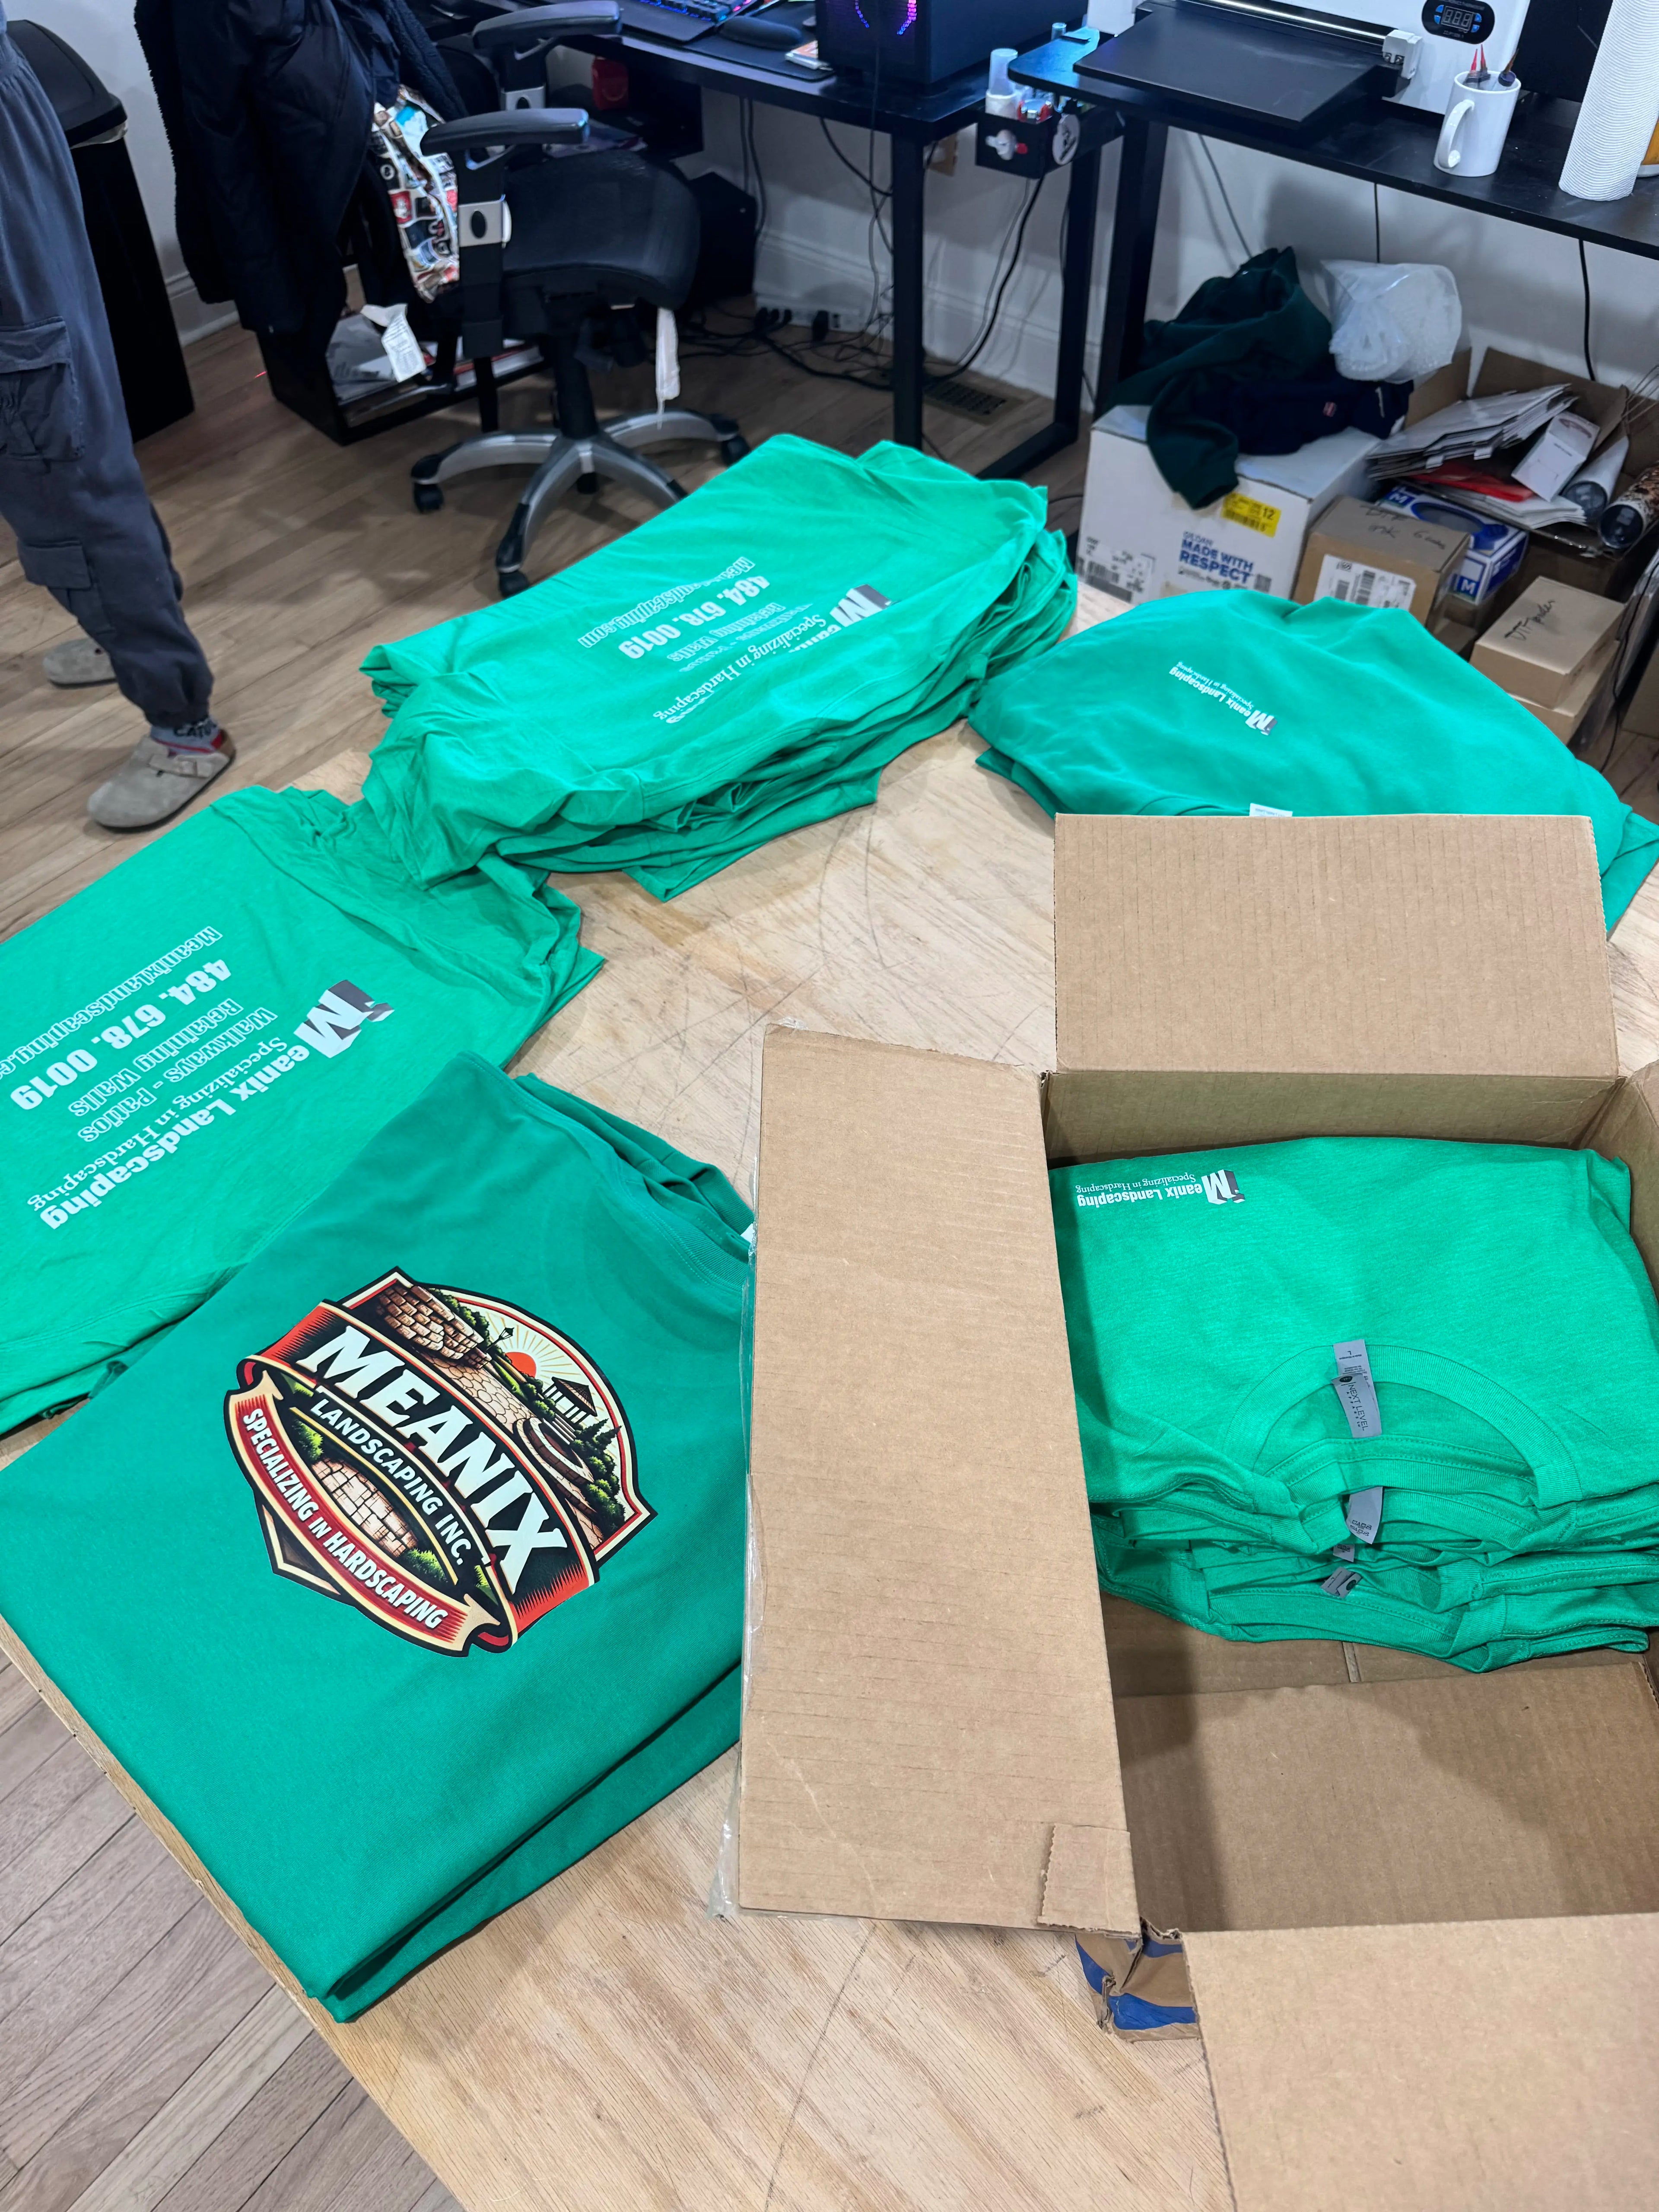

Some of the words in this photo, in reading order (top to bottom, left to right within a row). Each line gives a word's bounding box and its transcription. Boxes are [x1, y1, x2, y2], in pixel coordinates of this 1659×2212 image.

[1179, 550, 1252, 584] RESPECT
[1182, 539, 1217, 559] MADE
[1221, 552, 1253, 571] WITH
[717, 575, 770, 606] 484.
[1461, 579, 1475, 595] M
[674, 601, 726, 626] 678.
[710, 602, 786, 639] Retaining
[618, 623, 681, 659] 0019
[667, 635, 718, 661] Walls
[747, 614, 826, 661] Specializing
[737, 653, 756, 669] in
[1176, 661, 1214, 686] Hardscaping
[653, 666, 741, 721] Hardscaping
[1169, 666, 1227, 702] Landscaping
[1220, 683, 1254, 710] Specializing
[1226, 697, 1277, 735] Meanix
[159, 959, 232, 1005] 484.
[0, 925, 223, 1081] MeanixLandscaping.c
[91, 1004, 166, 1049] 678.
[133, 998, 244, 1072] Retaining
[163, 1007, 279, 1083] Walkways
[230, 979, 395, 1101] Meanix
[10, 1049, 98, 1110] 0019
[68, 1067, 140, 1117] Walls
[172, 1036, 288, 1110] Specializing
[78, 1087, 157, 1142] Patios
[156, 1109, 177, 1126] in
[27, 1125, 161, 1212] Hardscaping
[40, 1099, 236, 1230] Landscaping
[1142, 1172, 1196, 1187] Specializing
[1075, 1183, 1132, 1194] Hardscaping
[1077, 1188, 1163, 1208] Landscaping
[1133, 1181, 1142, 1189] in
[1166, 1169, 1246, 1205] Meanix
[1348, 1385, 1361, 1403] NEXT
[1356, 1405, 1368, 1431] LEVEL
[297, 1325, 569, 1595] MEANIX
[311, 1398, 442, 1513] LANDSCAPING
[434, 1513, 472, 1566] INC.
[243, 1408, 318, 1518] SPECIALIZING
[310, 1516, 330, 1541] IN
[323, 1530, 448, 1629] HARDSCAPING
